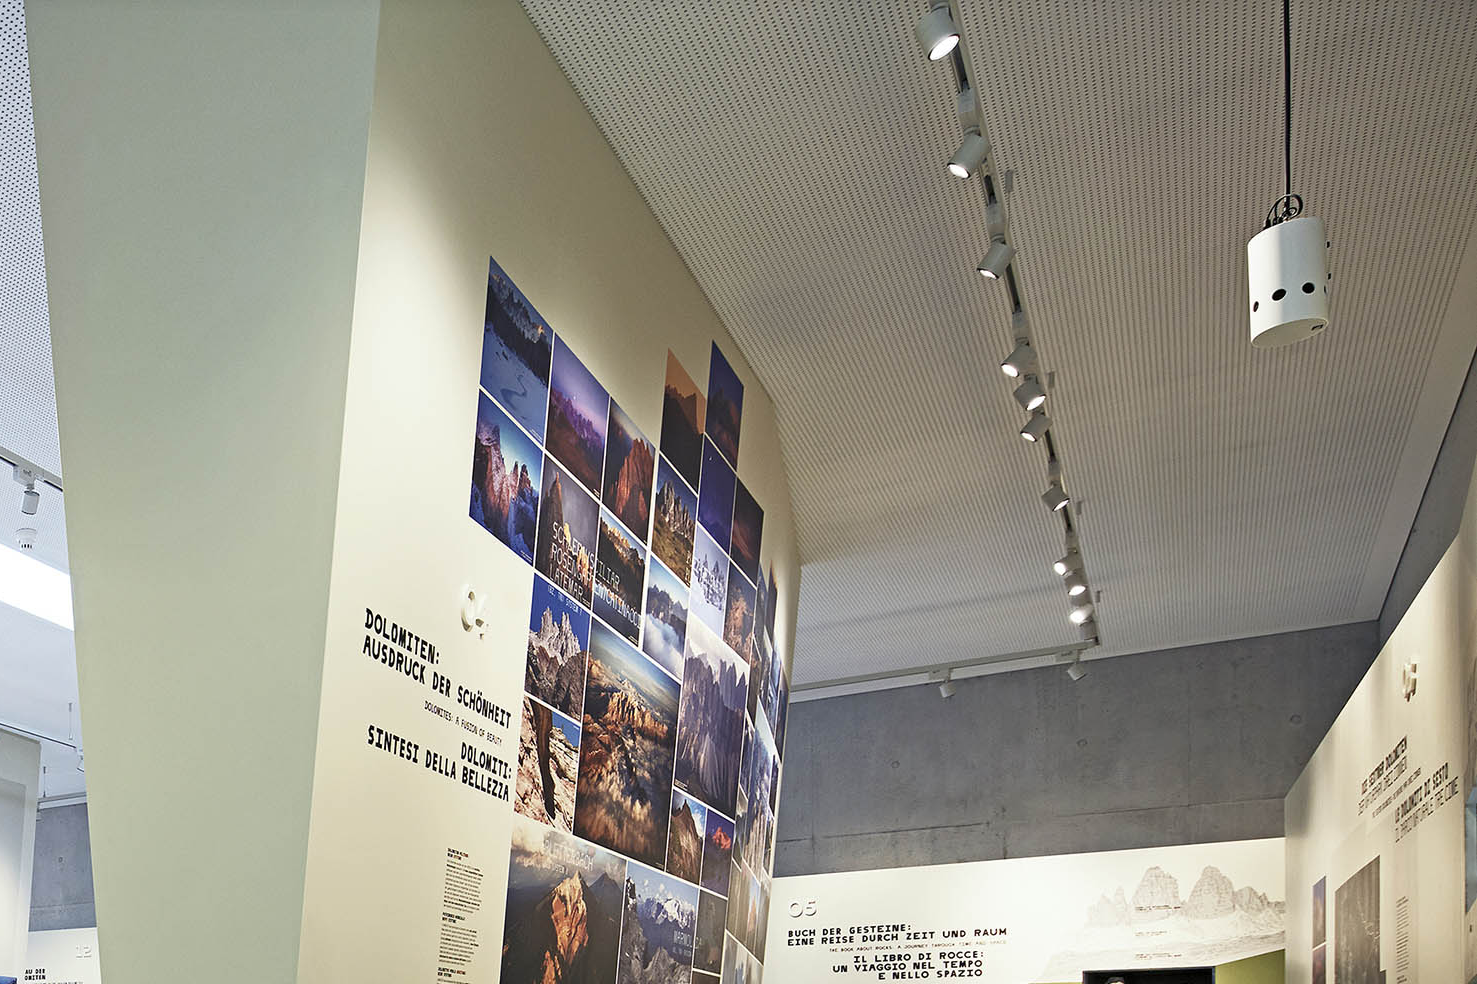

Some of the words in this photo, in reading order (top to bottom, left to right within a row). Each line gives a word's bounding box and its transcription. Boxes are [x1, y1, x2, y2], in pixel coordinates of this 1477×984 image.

[365, 608, 439, 664] DOLOMITEN:
[363, 635, 425, 684] AUSDRUCK
[433, 672, 450, 697] DER
[457, 685, 511, 729] SCHÖNHEIT
[461, 720, 477, 734] FUSION
[368, 725, 419, 764] SINTESI
[426, 750, 456, 779] DELLA
[462, 767, 509, 802] BELLEZZA
[461, 742, 512, 779] DOLOMITI:
[1401, 785, 1422, 818] DOLOMITI
[1425, 777, 1430, 798] DI
[1433, 761, 1448, 791] SESTO
[788, 900, 818, 918] 05
[788, 938, 814, 946] EINE
[822, 936, 854, 944] REISE
[862, 934, 898, 942] DURCH
[906, 932, 935, 940] ZEIT
[943, 930, 966, 938] UND
[974, 928, 1007, 936] RAUM
[849, 924, 911, 934] GESTEINE:
[855, 963, 906, 971] VIAGGIO
[943, 960, 982, 968] TEMPO
[875, 953, 911, 962] LIBRO
[940, 951, 984, 959] ROCCE:
[892, 971, 929, 979] NELLO
[937, 969, 982, 978] SPAZIO
